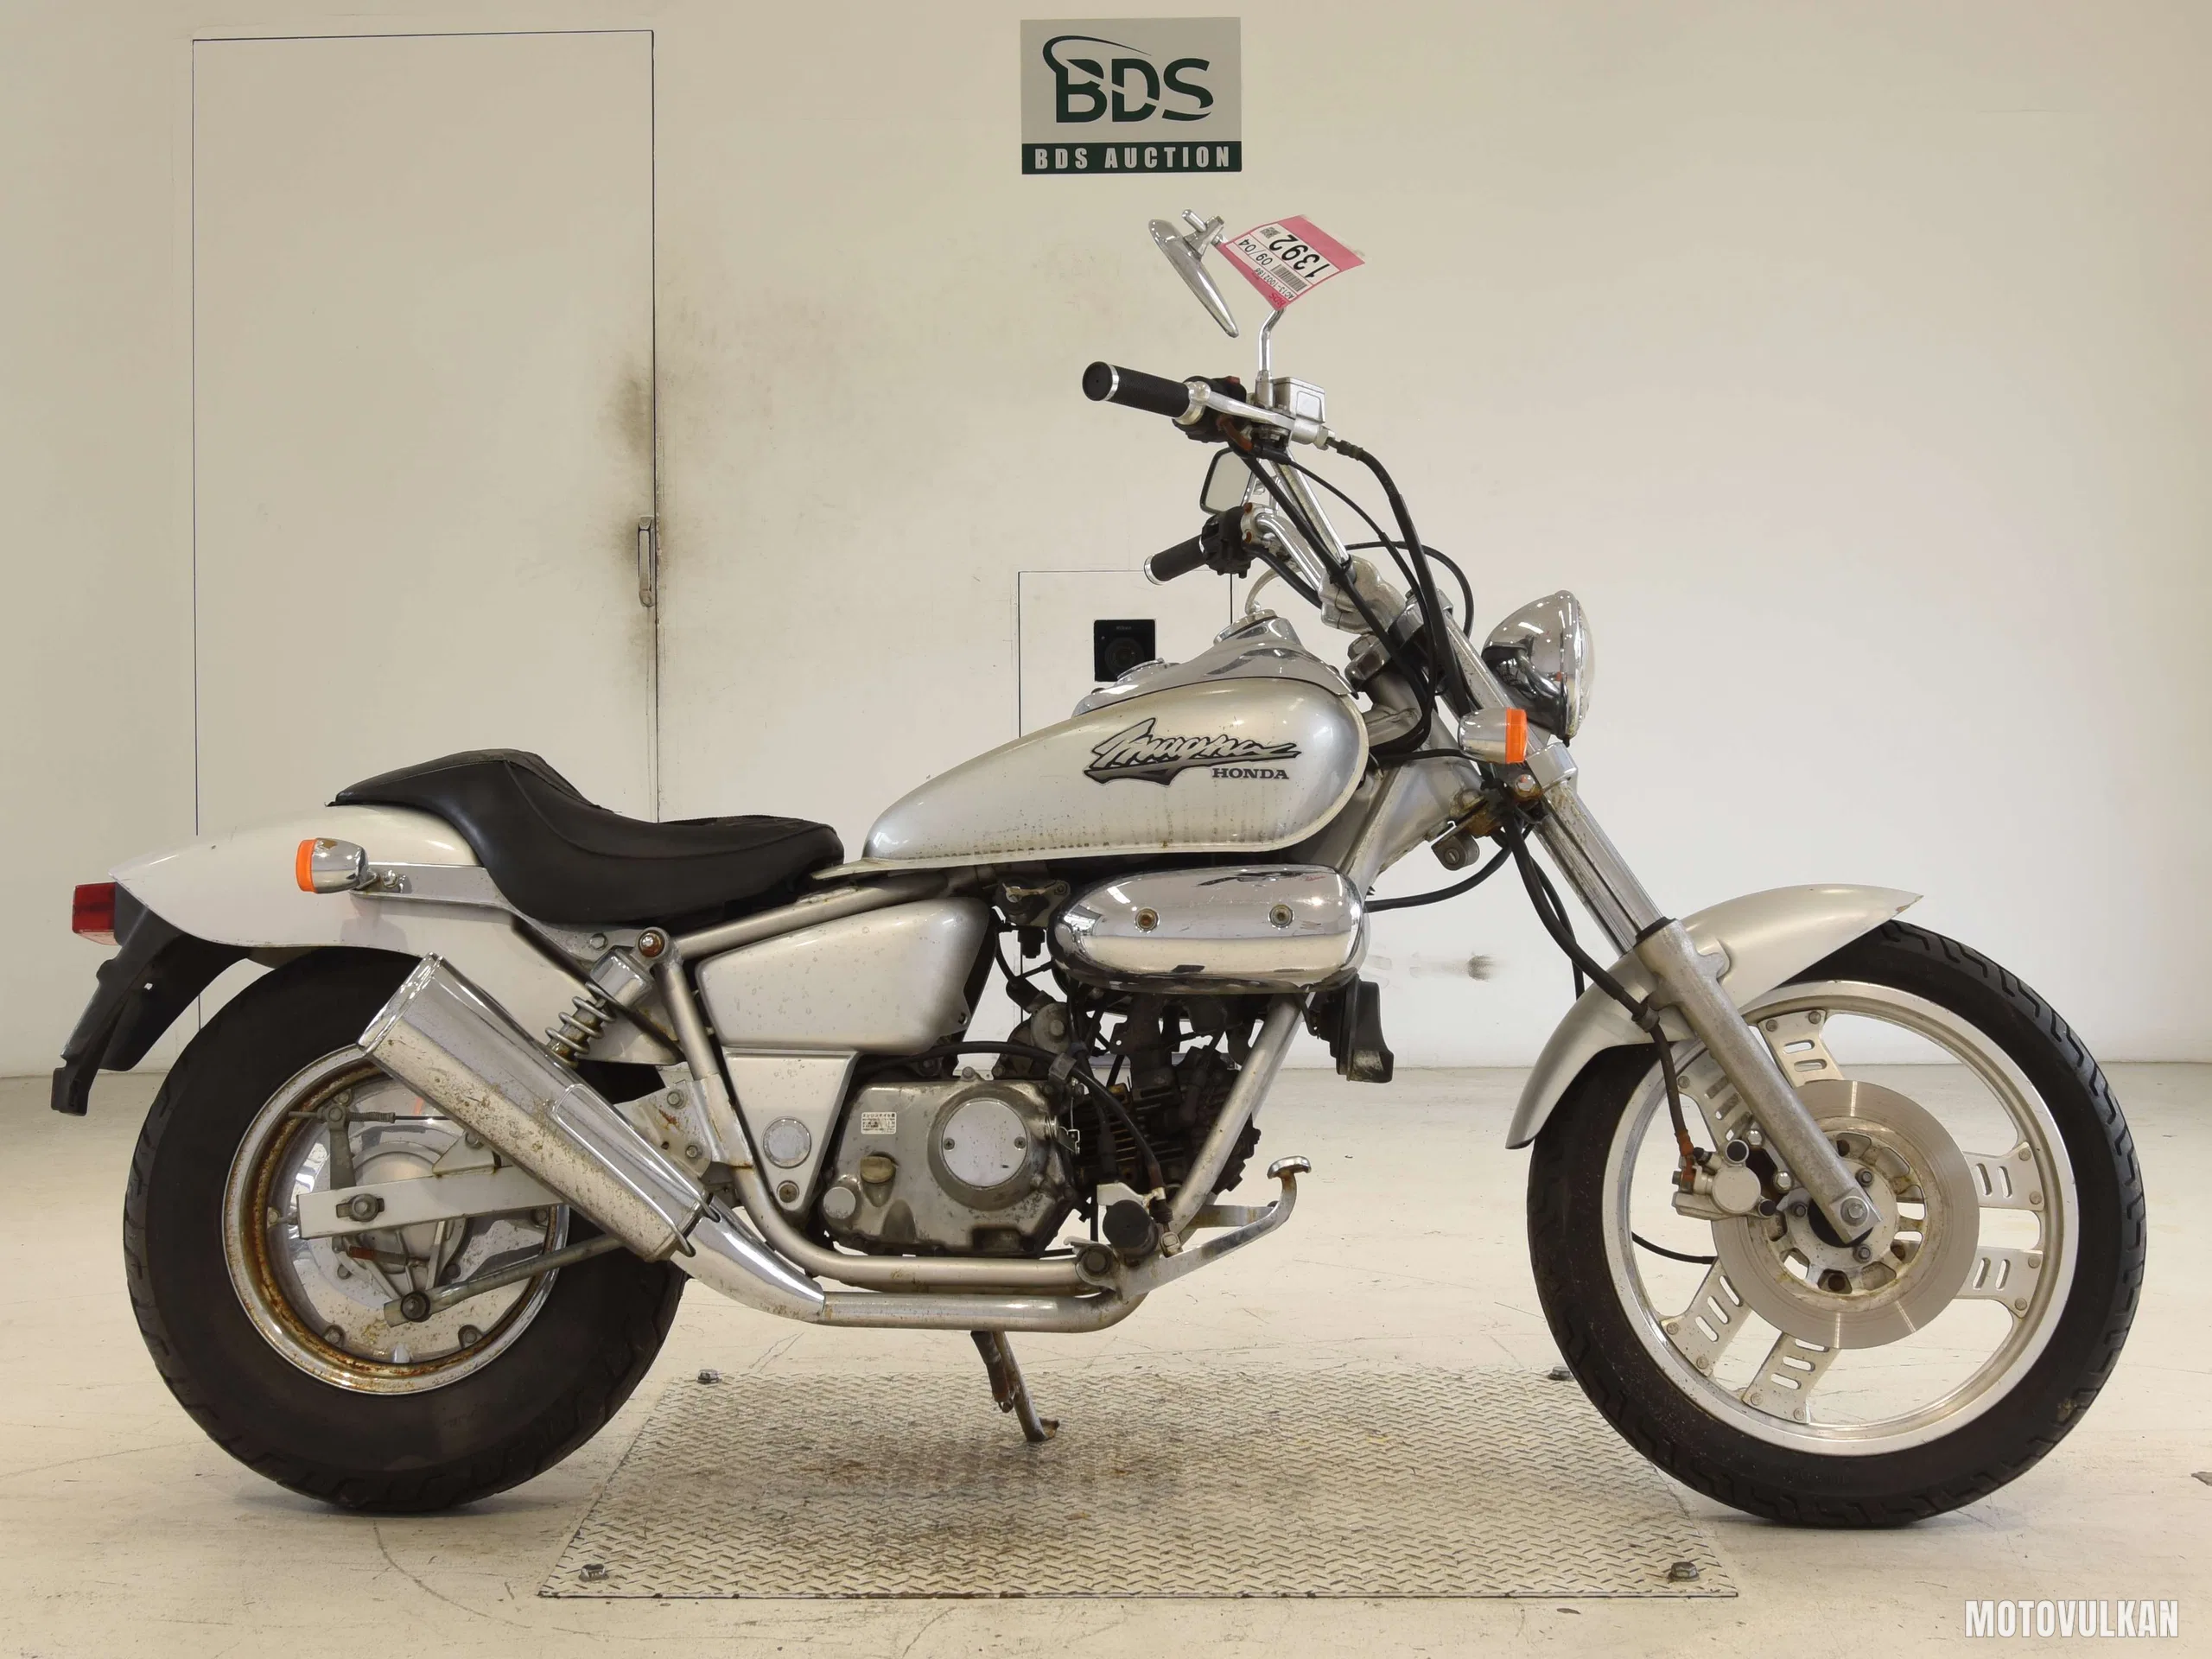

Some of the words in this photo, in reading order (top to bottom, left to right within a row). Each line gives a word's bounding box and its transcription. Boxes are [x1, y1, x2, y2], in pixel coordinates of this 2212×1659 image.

[1043, 35, 1214, 123] BDS
[1034, 148, 1088, 169] BDS
[1104, 146, 1230, 168] AUCTION
[1238, 238, 1273, 266] 09/04
[1268, 234, 1331, 278] 1392
[1211, 767, 1290, 780] HONDA
